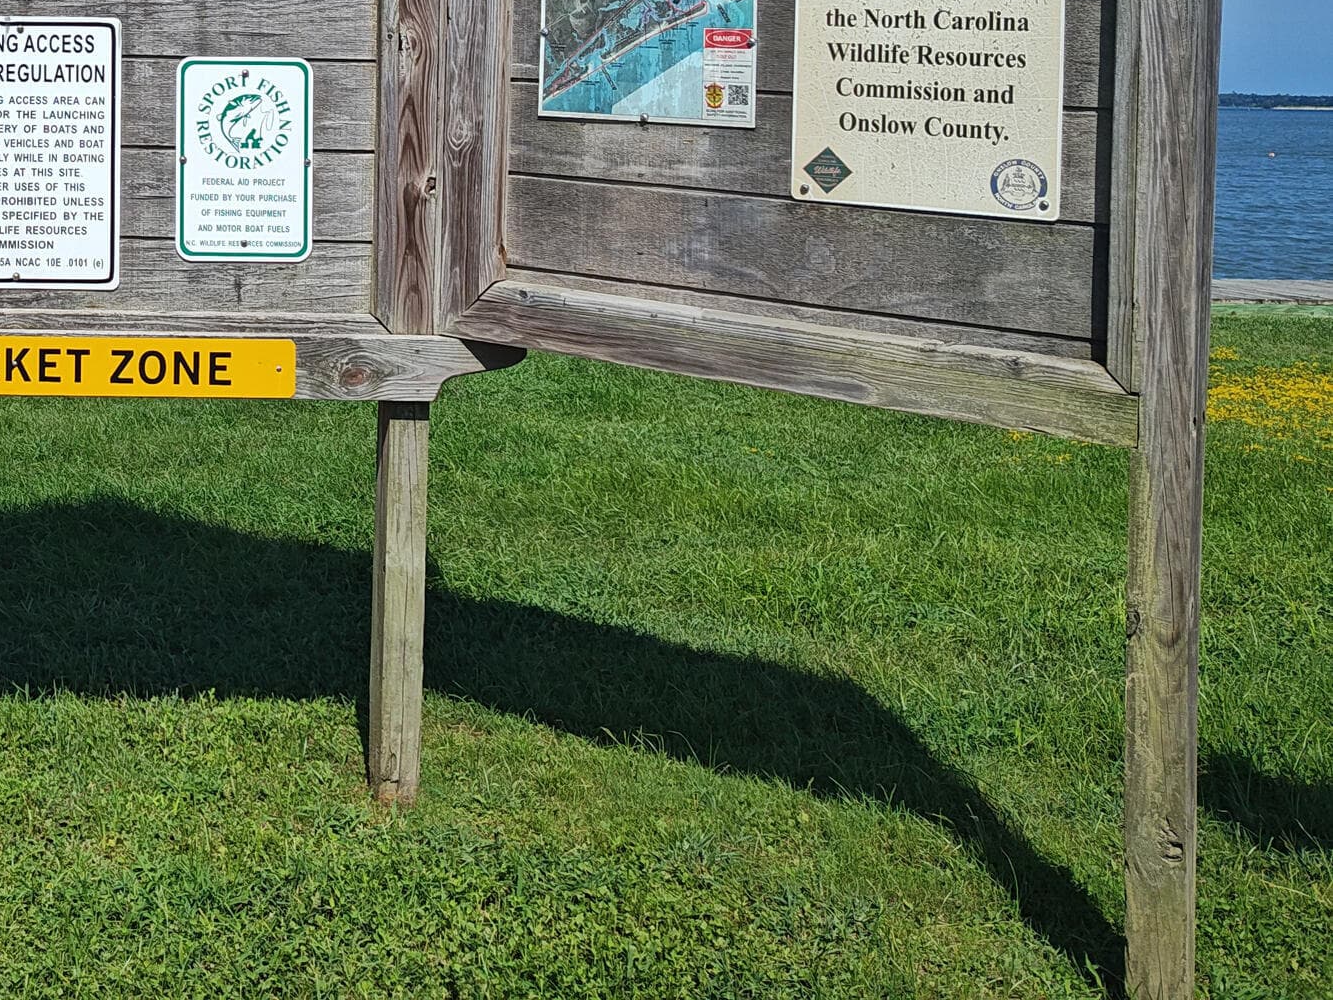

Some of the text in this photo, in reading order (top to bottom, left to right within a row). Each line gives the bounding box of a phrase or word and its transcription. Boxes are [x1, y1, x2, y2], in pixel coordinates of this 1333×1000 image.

[826, 9, 1029, 31] the North Carolina
[24, 34, 95, 53] ACCESS
[828, 42, 1026, 68] Wildlife Resources
[198, 74, 249, 115] SPORT
[836, 77, 1015, 104] Commission and
[9, 96, 48, 105] ACCESS
[53, 97, 79, 105] AREA
[85, 97, 105, 105] CAN
[257, 79, 292, 113] FISH
[17, 111, 36, 119] THE
[43, 111, 105, 119] LAUNCHING
[24, 125, 37, 133] OF
[44, 125, 77, 133] BOATS
[839, 112, 1009, 145] Onslow County.
[4, 139, 49, 148] VEHICLES
[55, 140, 73, 148] AND
[80, 140, 104, 148] BOAT
[197, 119, 292, 170] RESTORATION
[14, 153, 43, 162] WHILE
[49, 154, 57, 162] IN
[63, 154, 104, 163] BOATING
[14, 168, 25, 176] AT
[32, 168, 52, 177] THIS
[202, 178, 234, 186] FEDERAL
[238, 178, 249, 186] AID
[15, 183, 40, 191] USES
[46, 183, 58, 191] OF
[64, 183, 85, 191] THIS
[63, 197, 104, 206] UNLESS
[2, 211, 56, 220] SPECIFIED
[64, 212, 77, 220] BY
[83, 212, 104, 220] THE
[26, 226, 87, 235] RESOURCES
[110, 350, 232, 387] ZONE
